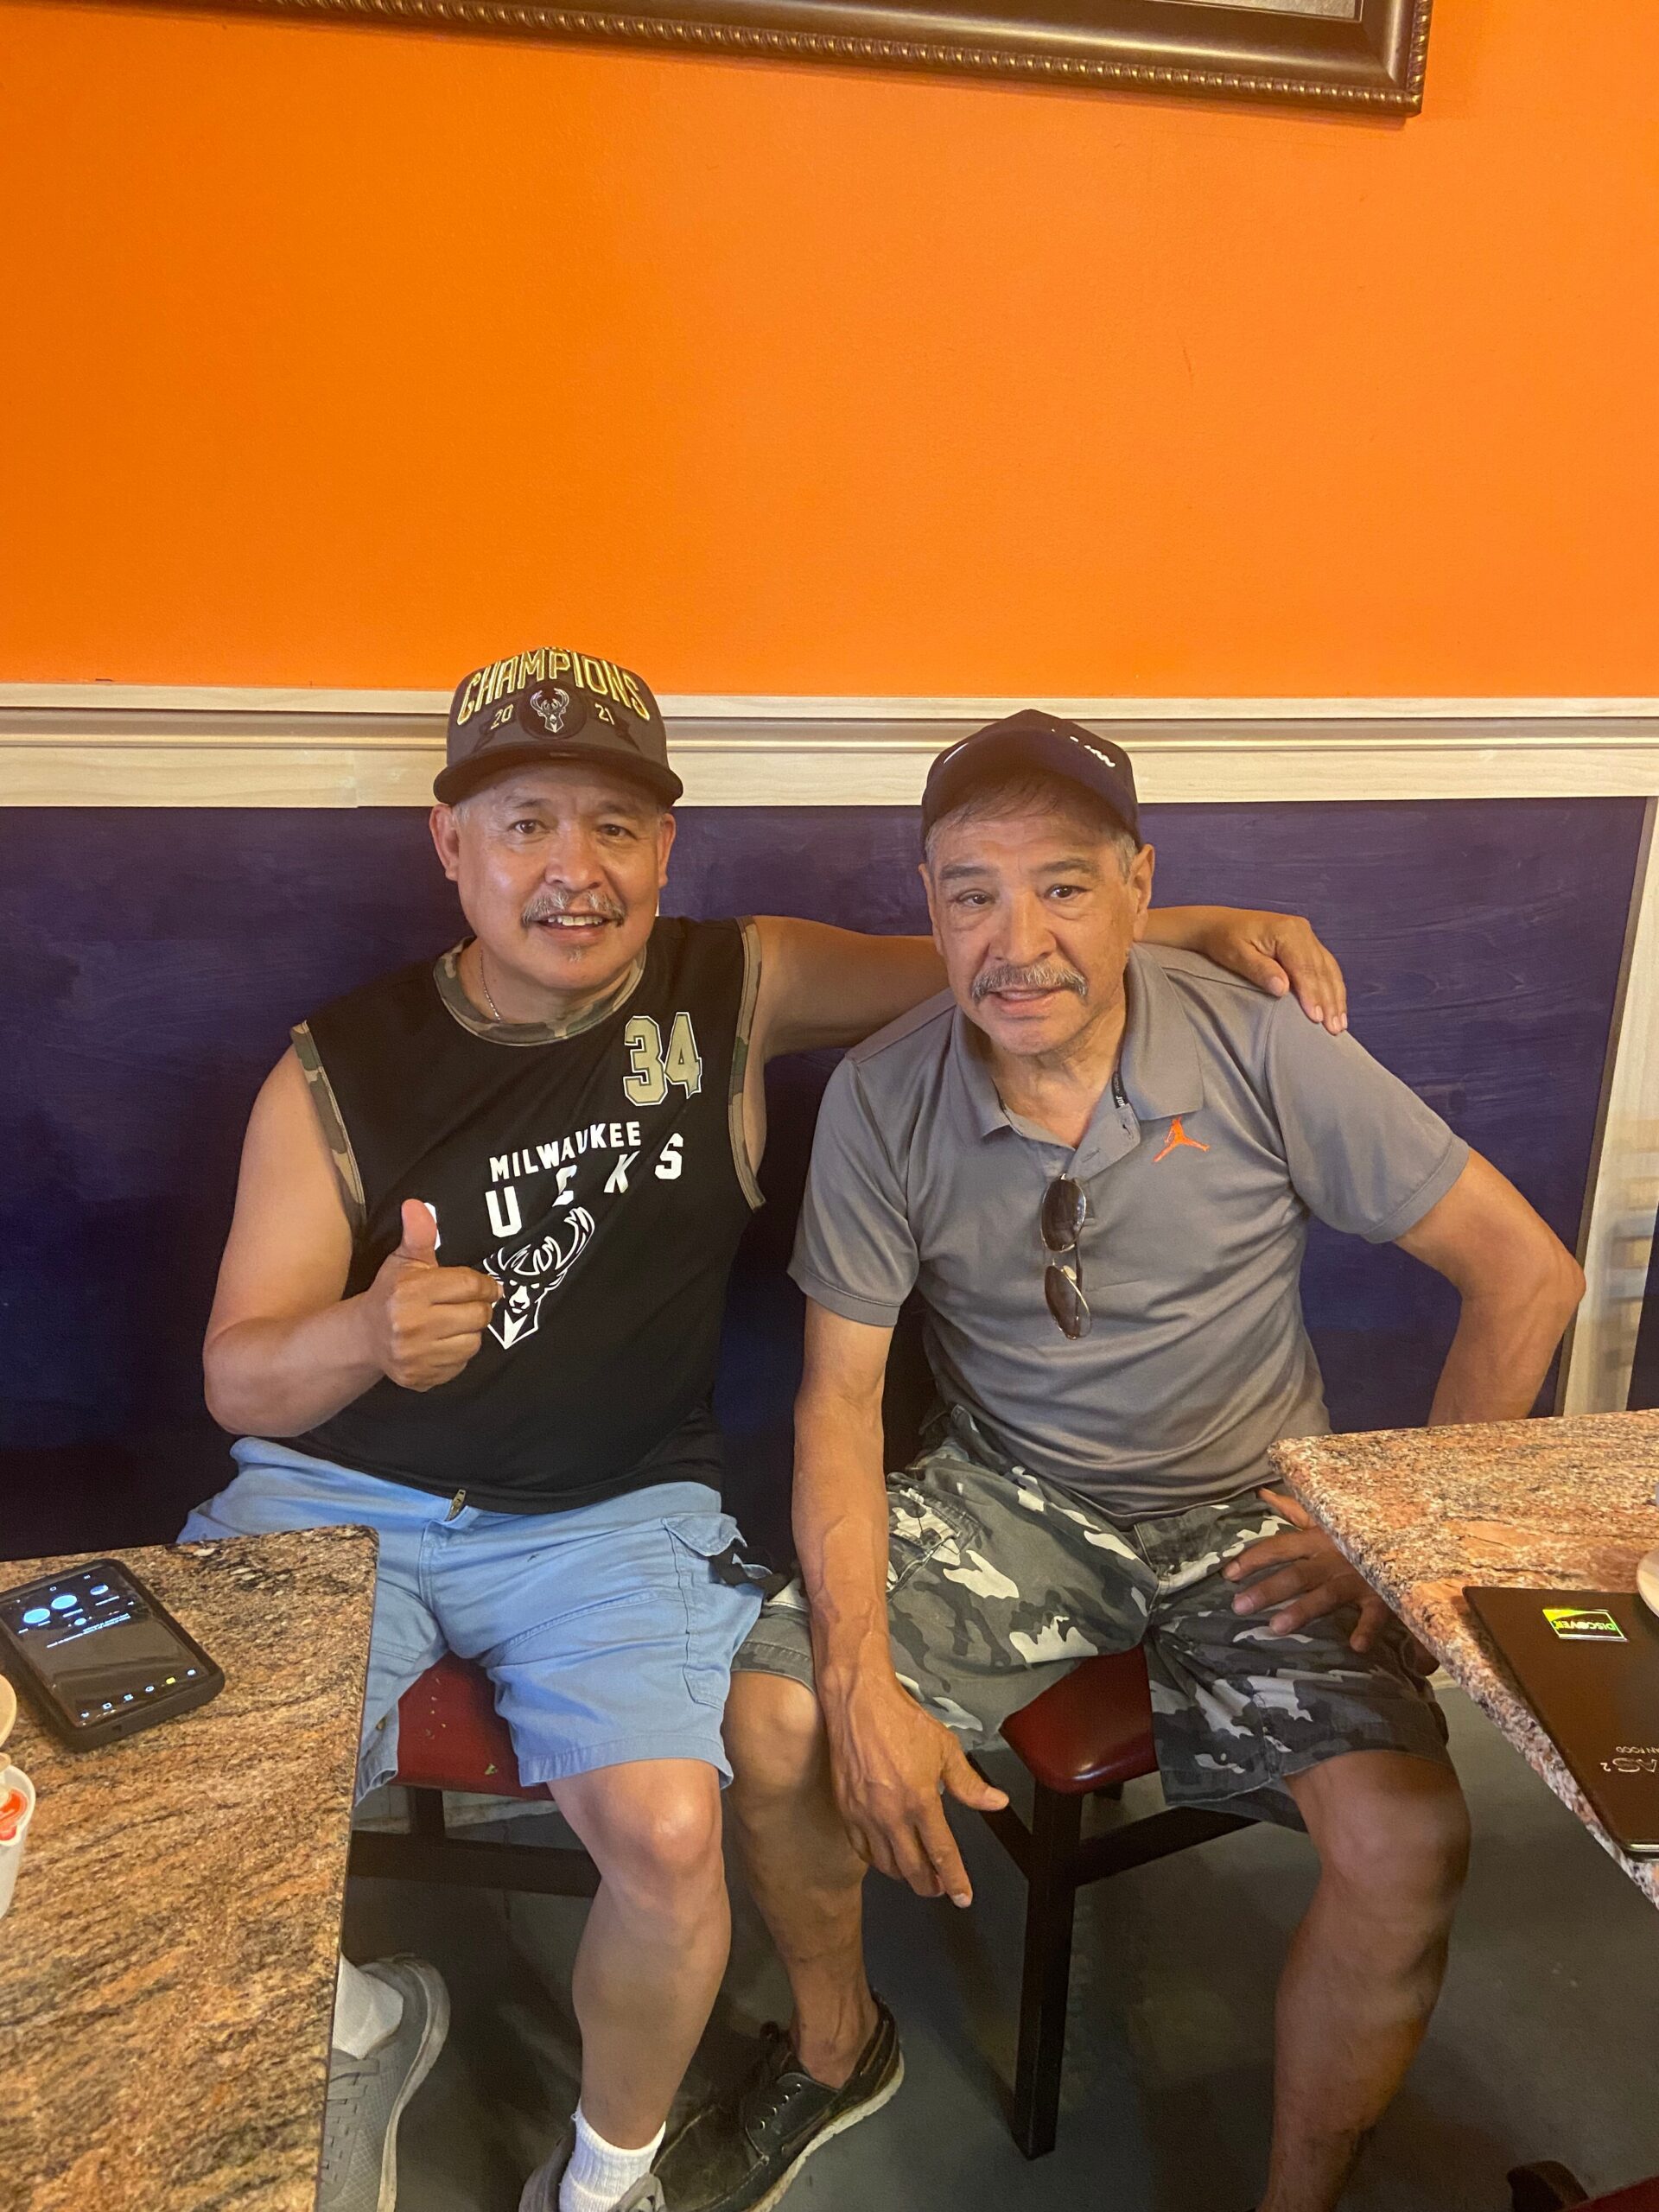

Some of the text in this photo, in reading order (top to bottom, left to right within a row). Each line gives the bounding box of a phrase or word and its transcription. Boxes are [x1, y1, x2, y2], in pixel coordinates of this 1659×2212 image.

[456, 647, 650, 726] CHAMPIONS
[491, 702, 615, 730] 20 21
[622, 1011, 702, 1107] 34
[490, 1121, 642, 1183] MILWAUKEE
[423, 1133, 684, 1251] UCKS
[1553, 1620, 1618, 1631] DISCOVER
[1615, 1745, 1646, 1754] FOOD
